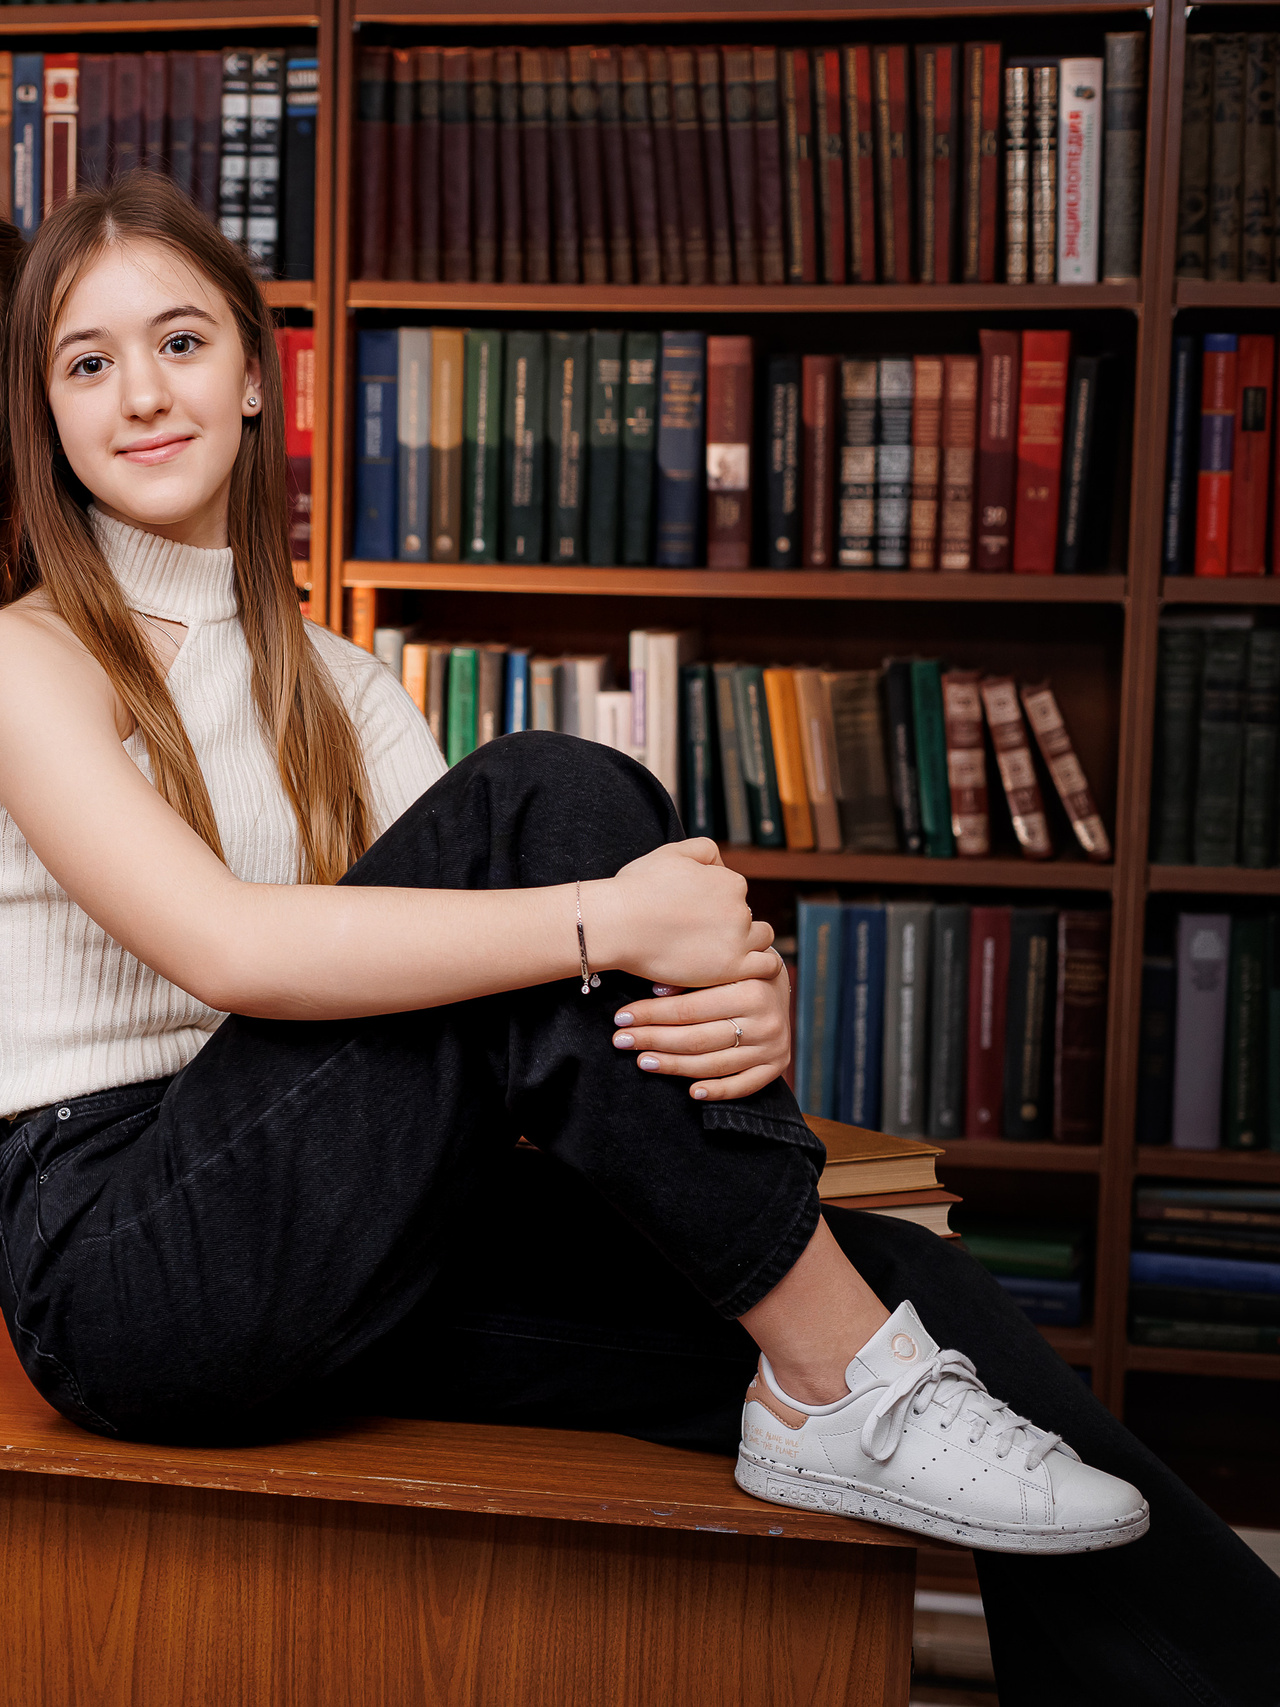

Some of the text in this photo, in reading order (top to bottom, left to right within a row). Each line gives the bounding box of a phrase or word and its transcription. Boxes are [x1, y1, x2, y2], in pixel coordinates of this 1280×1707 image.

[936, 134, 950, 157] 5
[982, 131, 997, 156] 6
[1065, 110, 1084, 259] ЭНЦИКЛОПЕДИЯ
[775, 1445, 800, 1459] PLANET
[770, 1484, 817, 1503] adidas
